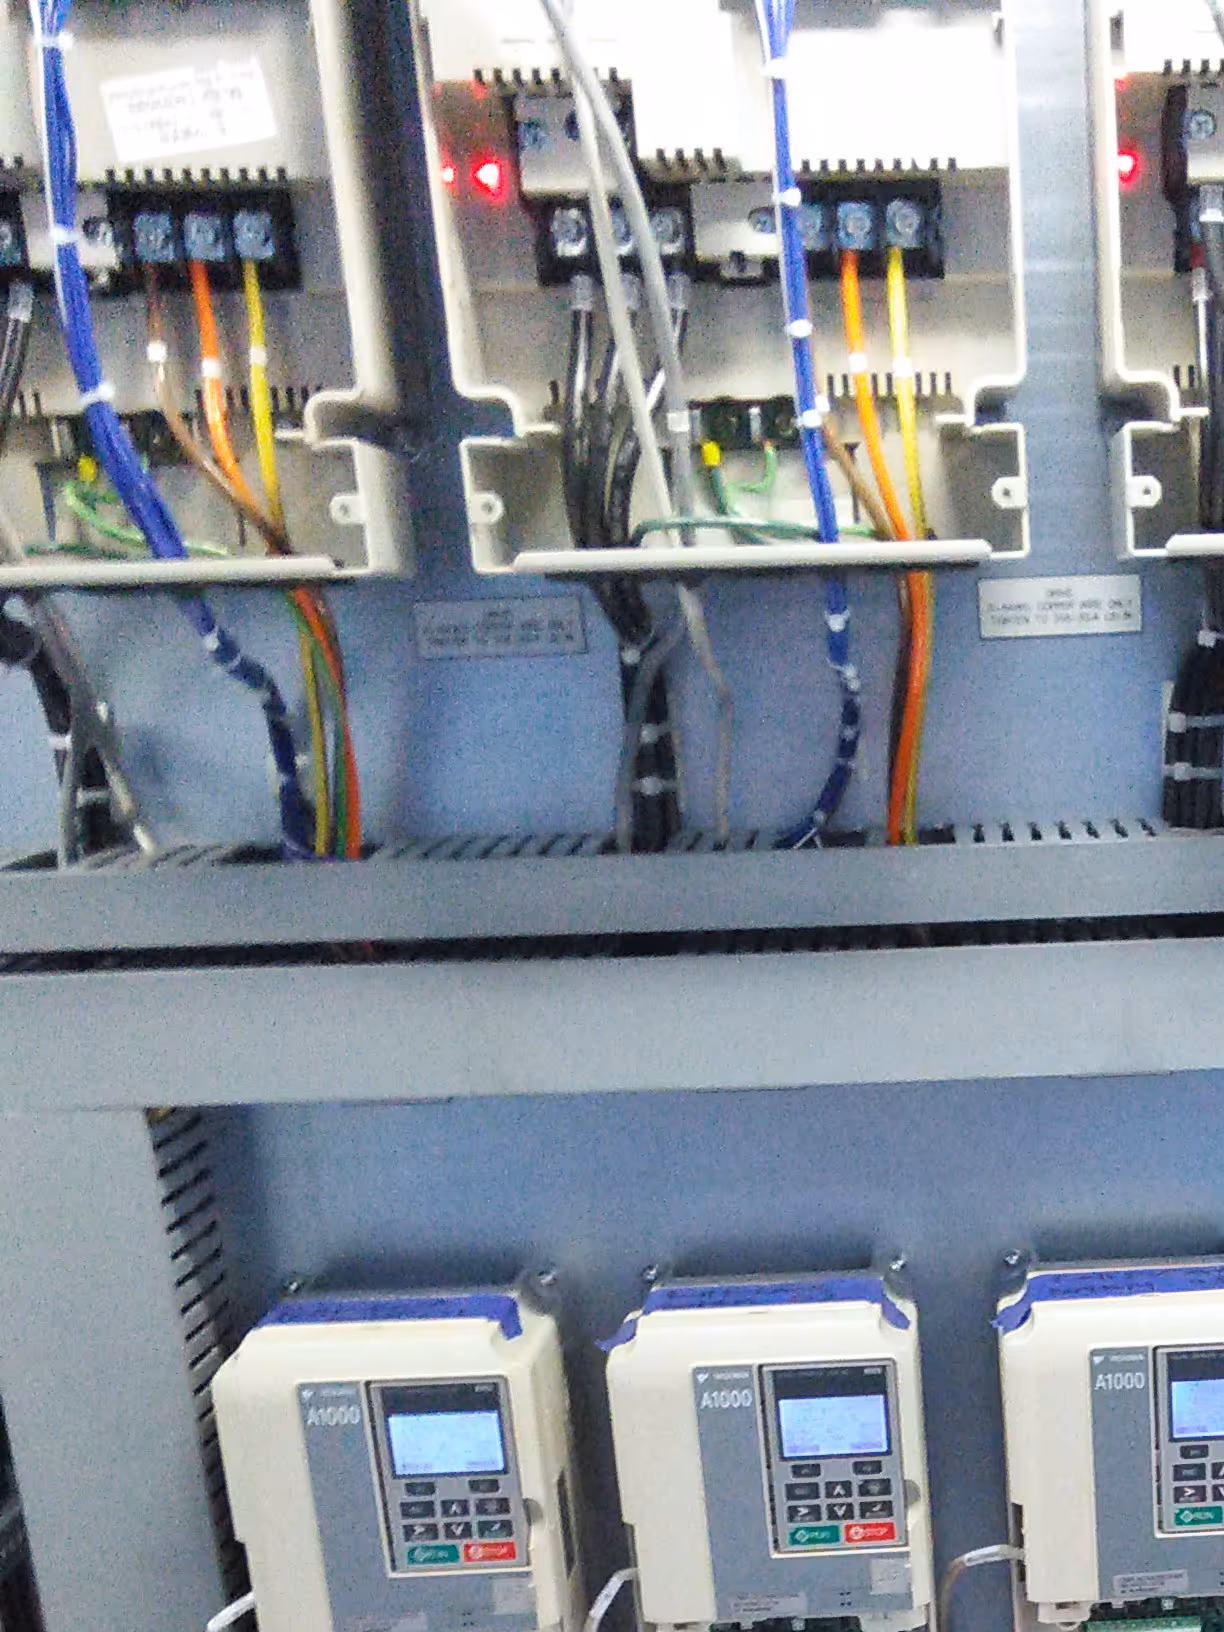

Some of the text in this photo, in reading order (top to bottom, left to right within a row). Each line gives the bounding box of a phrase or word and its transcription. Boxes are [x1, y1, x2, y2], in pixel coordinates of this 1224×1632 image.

[1094, 1372, 1145, 1390] A1000
[700, 1389, 752, 1409] A1000
[306, 1407, 361, 1426] A1000
